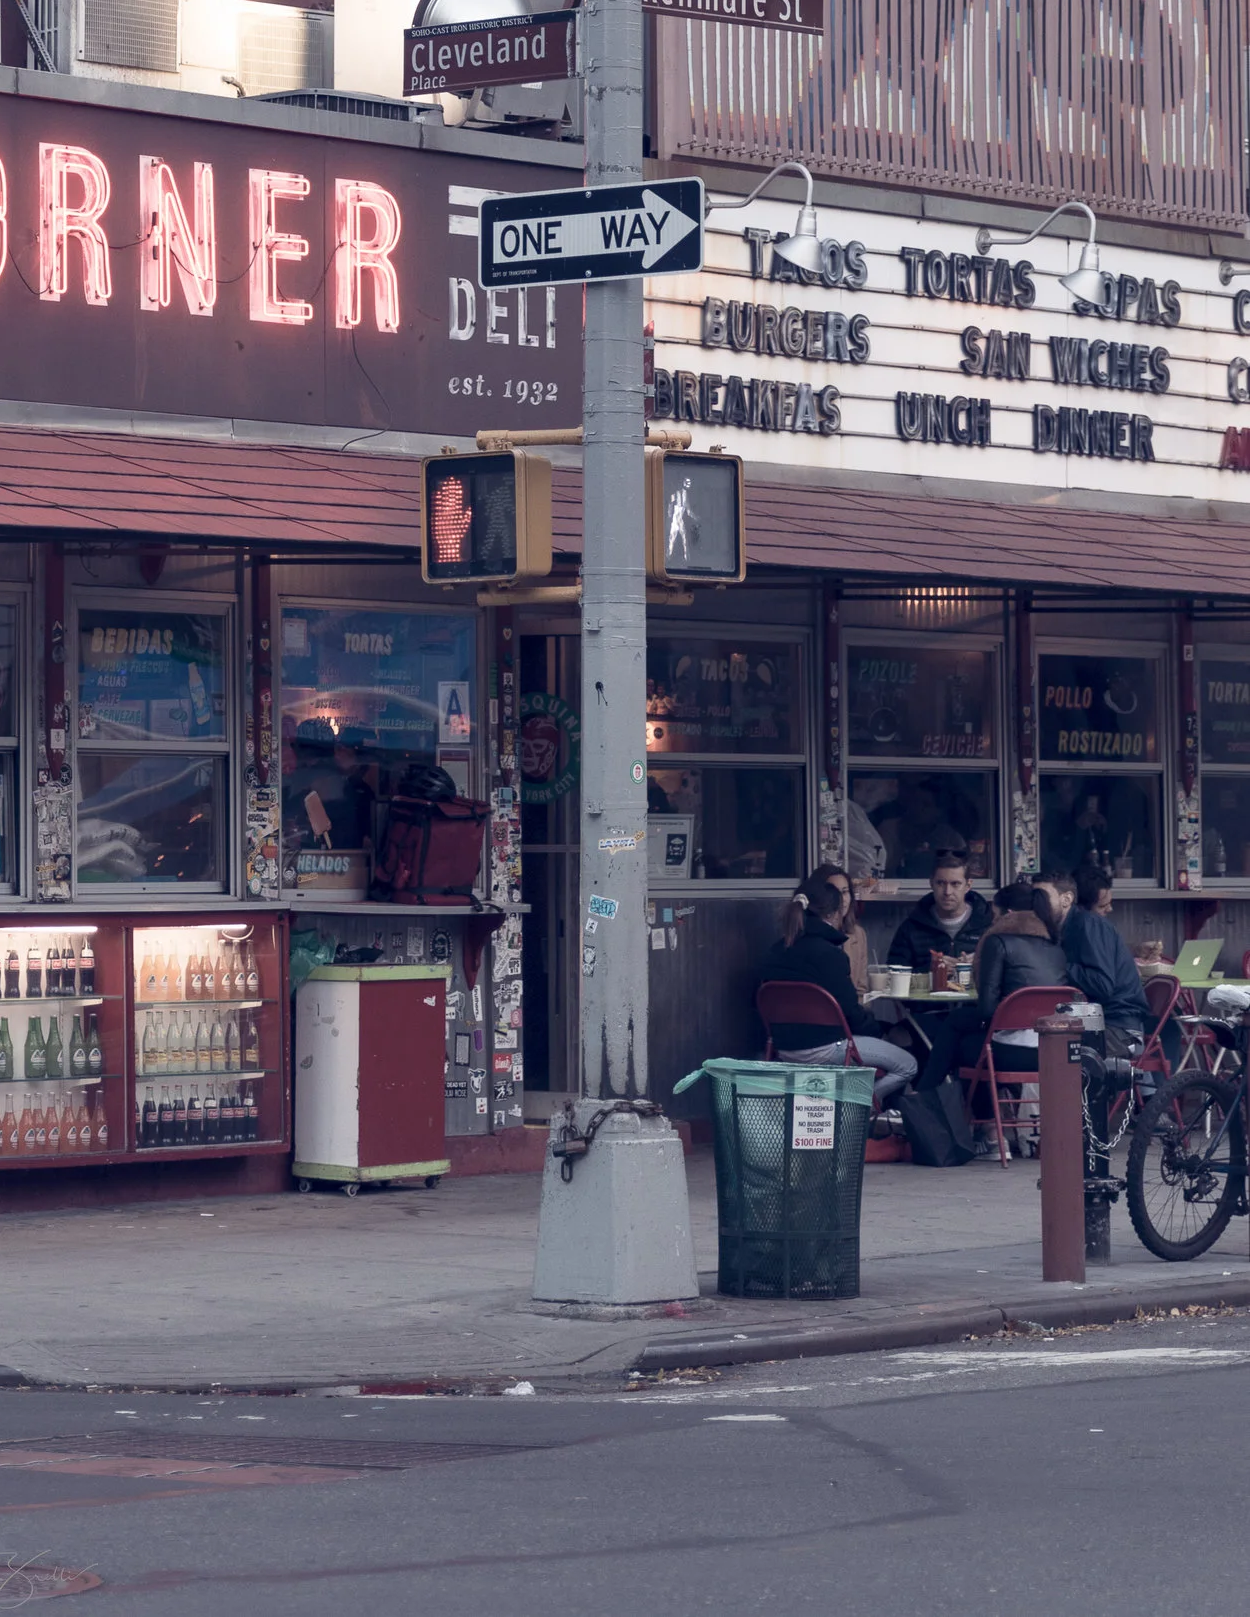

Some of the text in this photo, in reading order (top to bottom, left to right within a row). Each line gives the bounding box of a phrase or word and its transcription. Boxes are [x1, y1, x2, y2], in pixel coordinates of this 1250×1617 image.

[450, 23, 468, 33] IRON
[468, 19, 500, 31] HISTORIC
[501, 15, 534, 27] DISTRICT
[411, 26, 546, 73] Cleveland
[411, 74, 447, 91] Place
[500, 210, 671, 259] ONE WAY
[744, 226, 1182, 327] TAOS TORTAS OPAS
[448, 277, 557, 349] DELI
[702, 295, 1171, 395] BURGERS SAN WICHES
[448, 373, 559, 406] est. 1932
[653, 367, 1155, 462] BREAKFAS UNCH DINNER
[90, 627, 174, 655] BEBIDAS
[344, 632, 394, 656] TORTAS
[96, 674, 128, 688] AGUAS
[701, 657, 750, 683] TACOS
[858, 659, 919, 684] POZOLE
[315, 698, 342, 710] BISTEC
[1045, 685, 1093, 710] POLLO
[519, 694, 581, 743] SQUINA
[922, 733, 986, 757] CEVICHE
[1058, 729, 1143, 757] ROSTIZADO
[296, 854, 350, 874] HELADOS
[794, 1137, 833, 1147] $100 FINE
